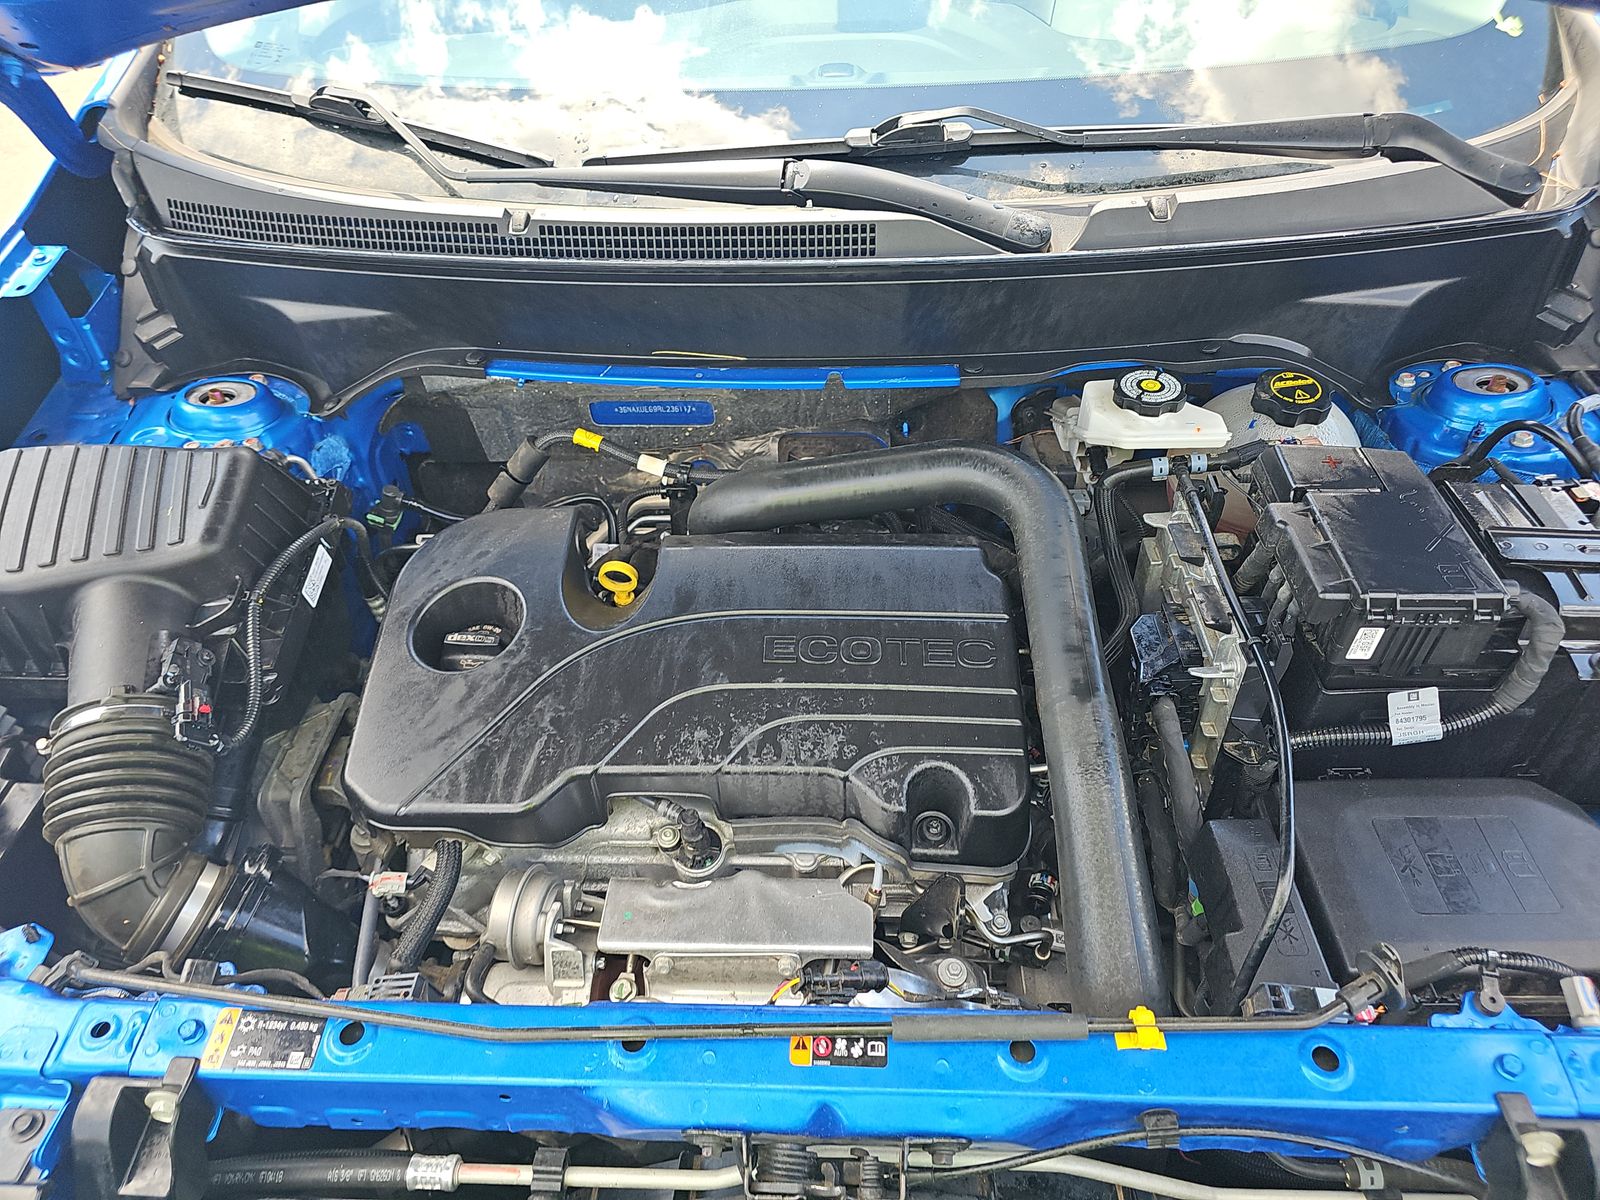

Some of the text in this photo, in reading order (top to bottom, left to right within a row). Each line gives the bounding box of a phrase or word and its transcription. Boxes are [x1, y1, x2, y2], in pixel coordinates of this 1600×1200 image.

[446, 633, 495, 643] dexos
[763, 635, 997, 669] ECOTEC
[834, 1049, 848, 1057] AUTO
